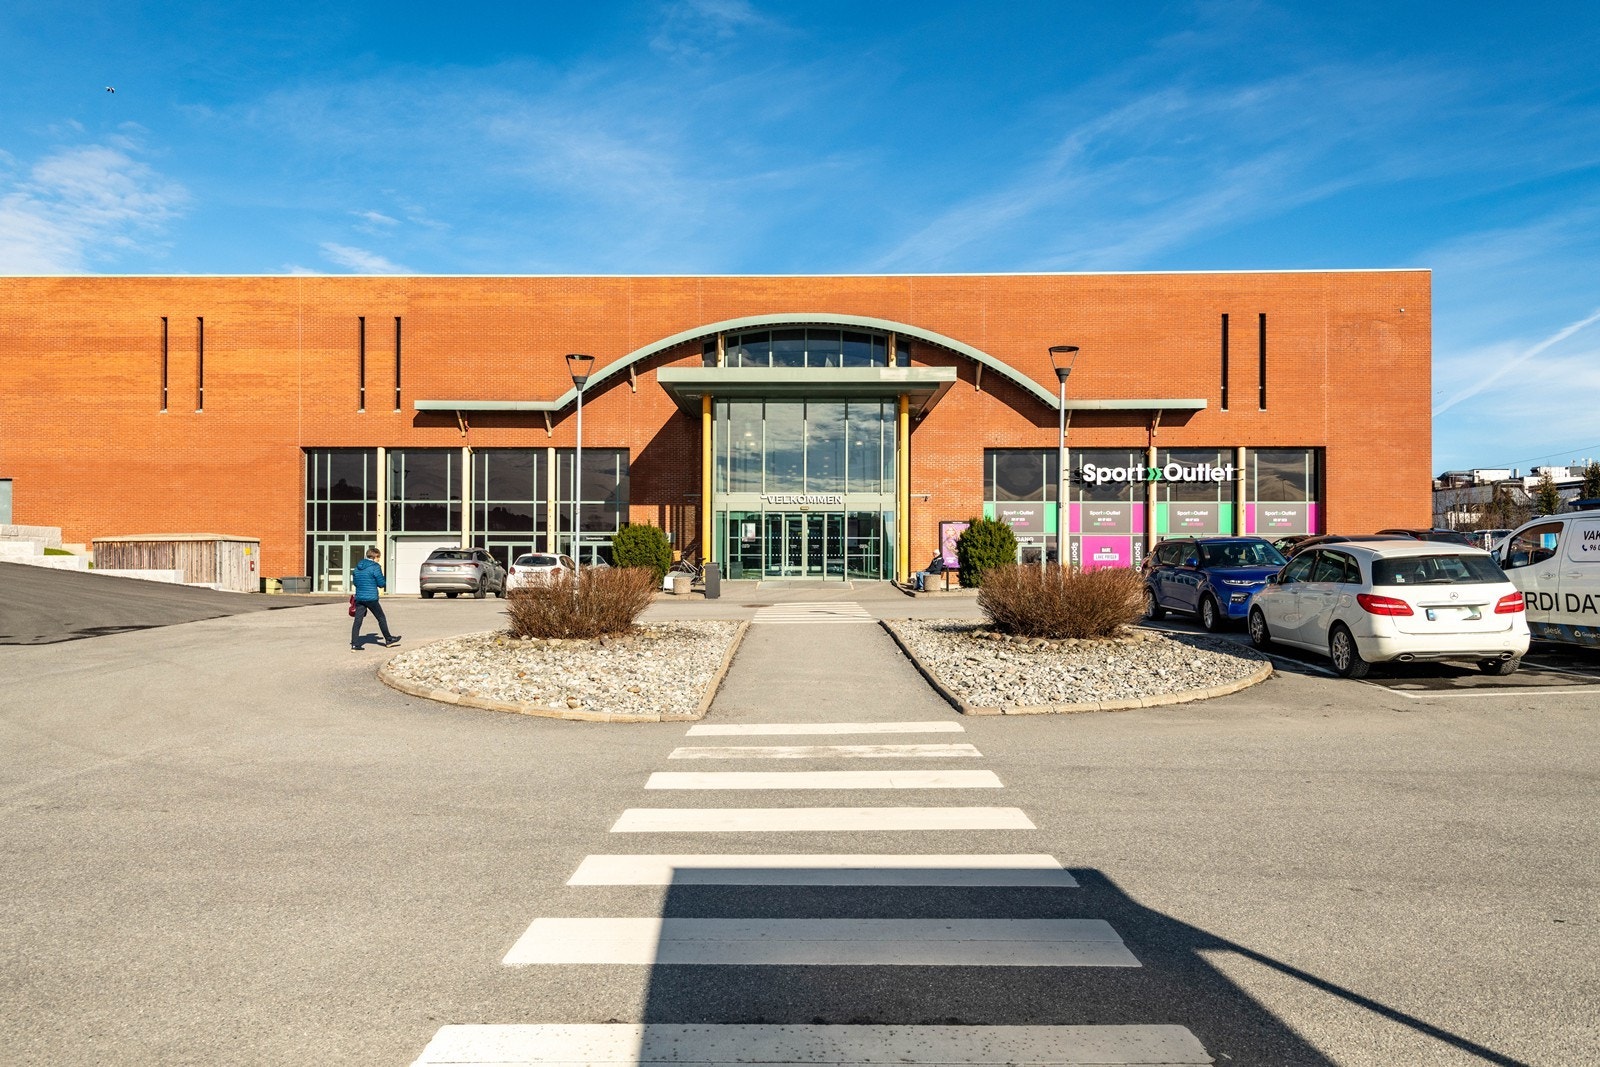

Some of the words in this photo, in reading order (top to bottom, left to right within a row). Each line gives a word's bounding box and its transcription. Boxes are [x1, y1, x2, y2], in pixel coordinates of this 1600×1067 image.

[1082, 463, 1144, 485] Sport
[1163, 463, 1234, 482] Outlet
[767, 495, 842, 505] VELKOMMEN
[1071, 542, 1079, 561] Sport
[1134, 542, 1142, 561] Sport
[1520, 591, 1560, 612] RDI
[1543, 626, 1562, 635] plesk
[1581, 631, 1596, 639] Google
